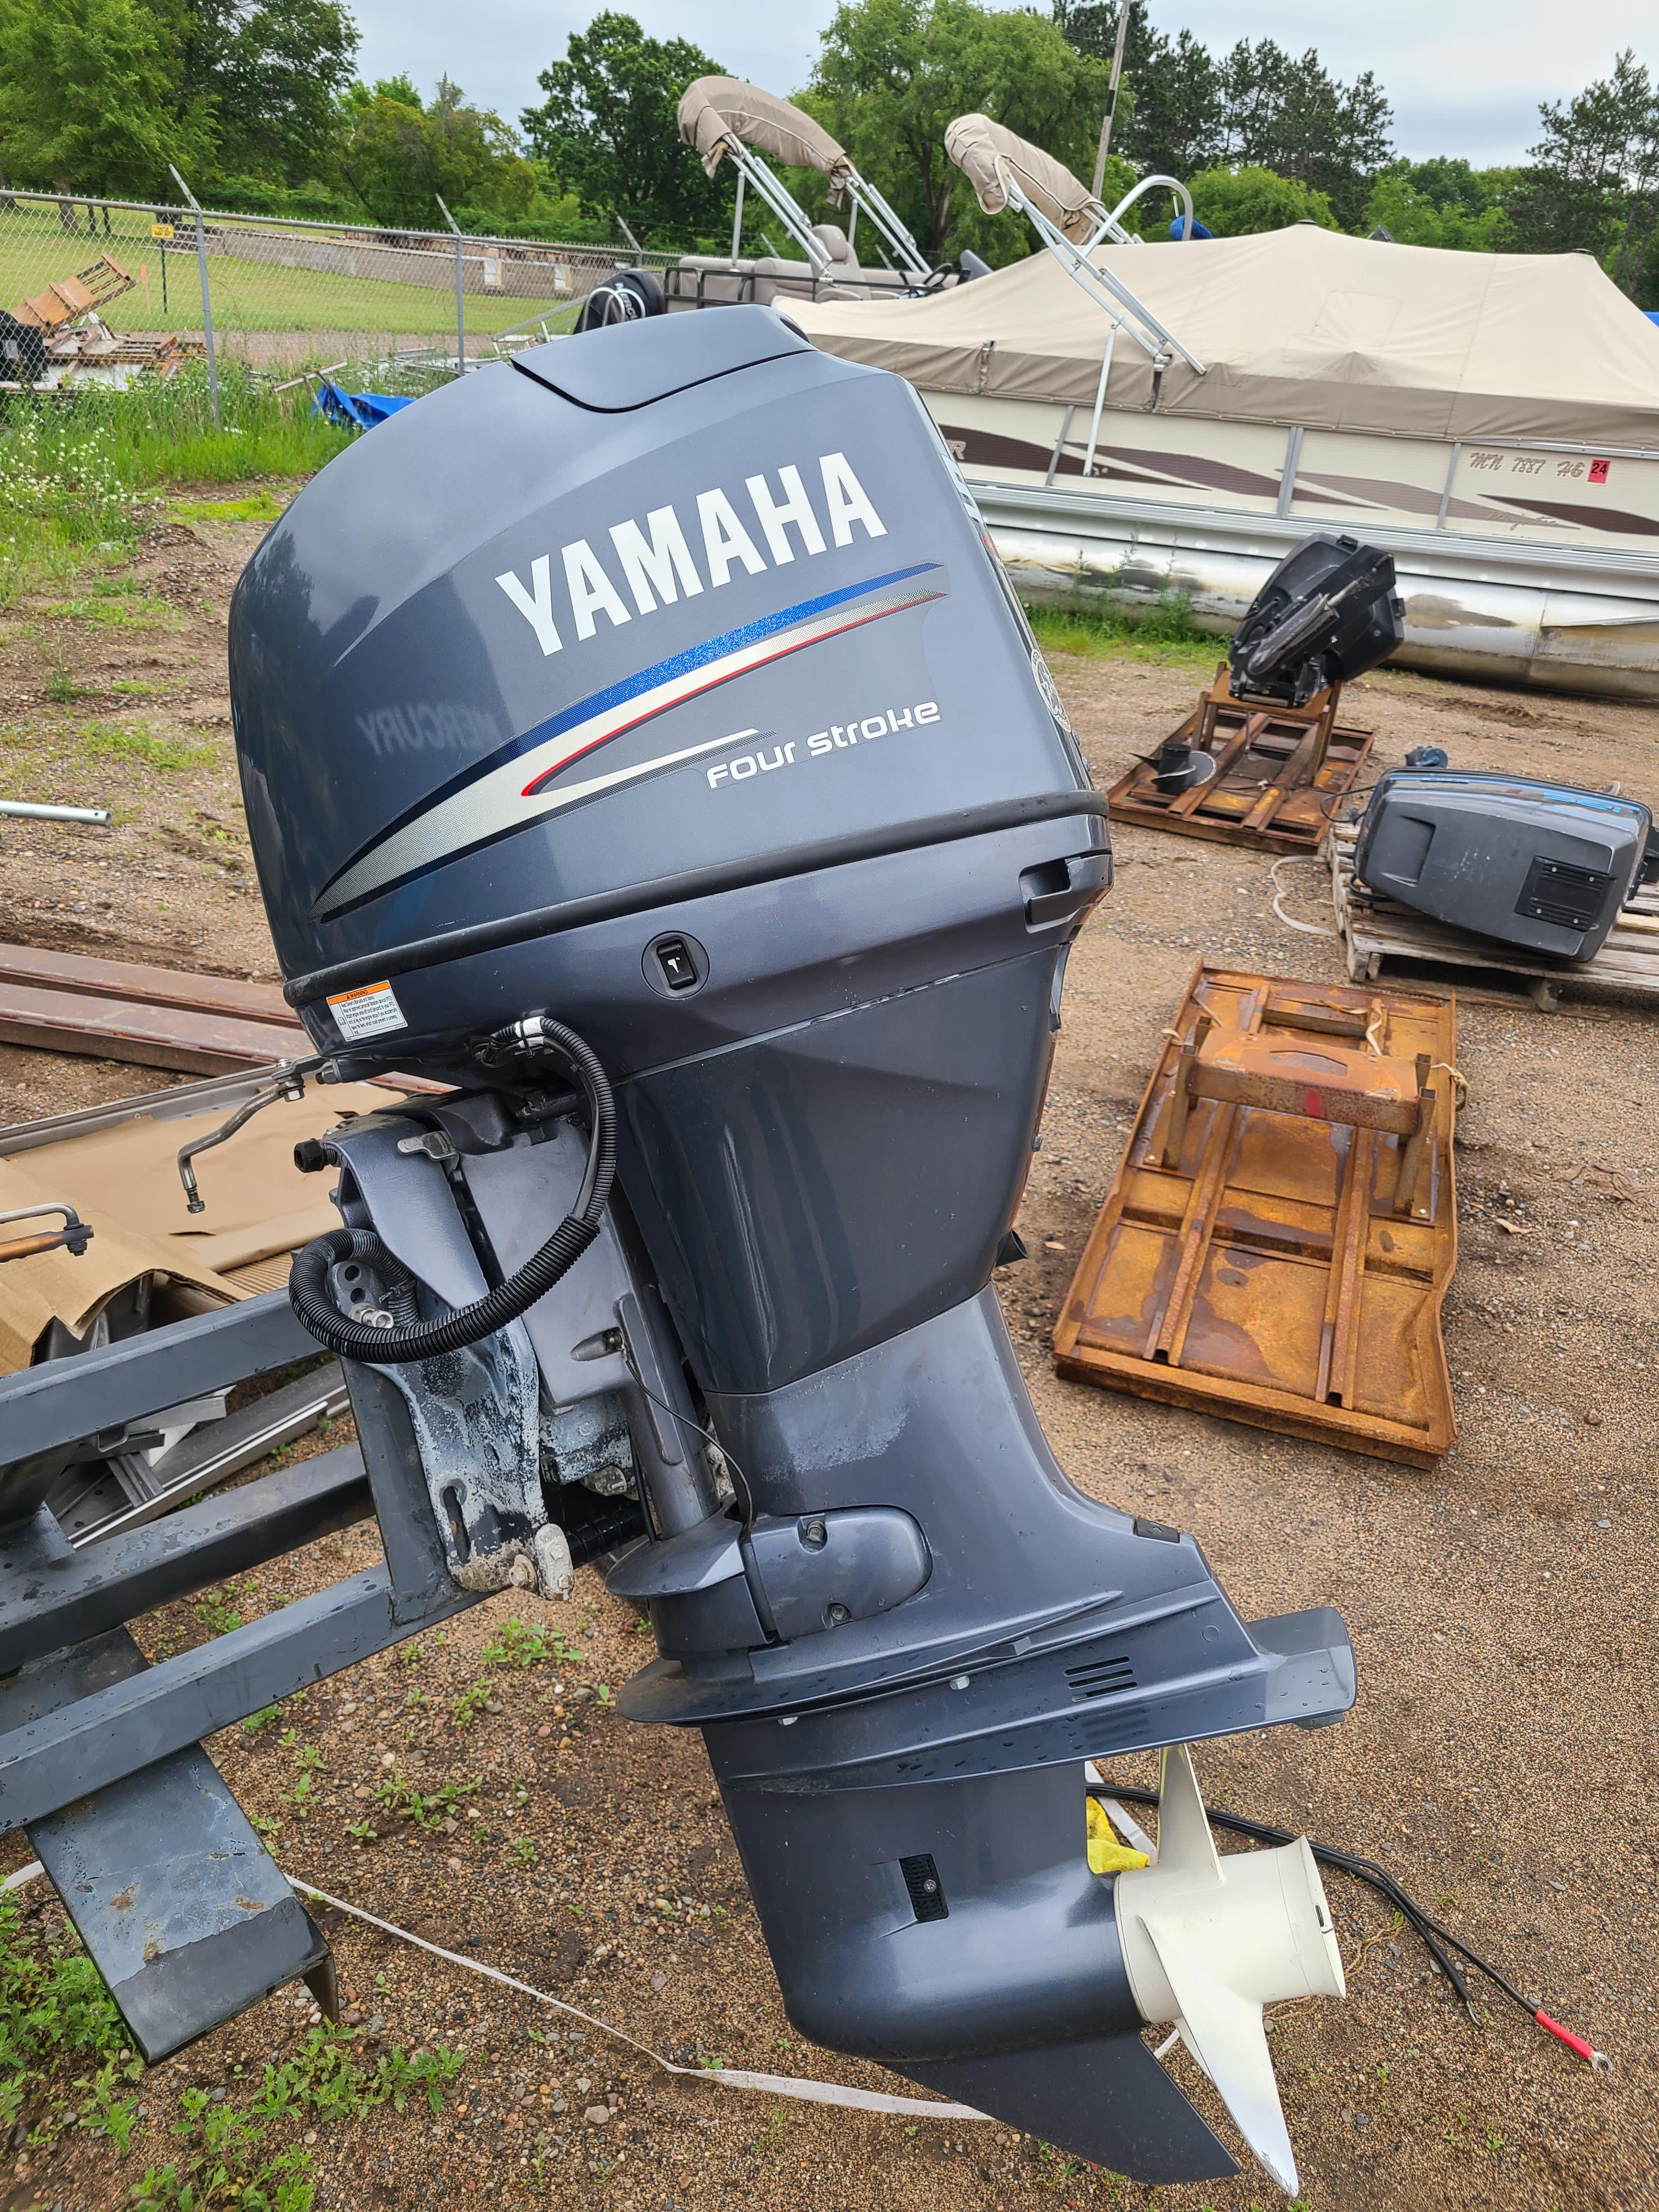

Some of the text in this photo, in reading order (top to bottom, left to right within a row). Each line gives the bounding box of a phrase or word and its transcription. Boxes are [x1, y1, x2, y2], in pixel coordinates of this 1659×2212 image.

[1511, 458, 1546, 475] 7887
[1591, 462, 1607, 475] 24
[494, 451, 889, 657] YAMAHA
